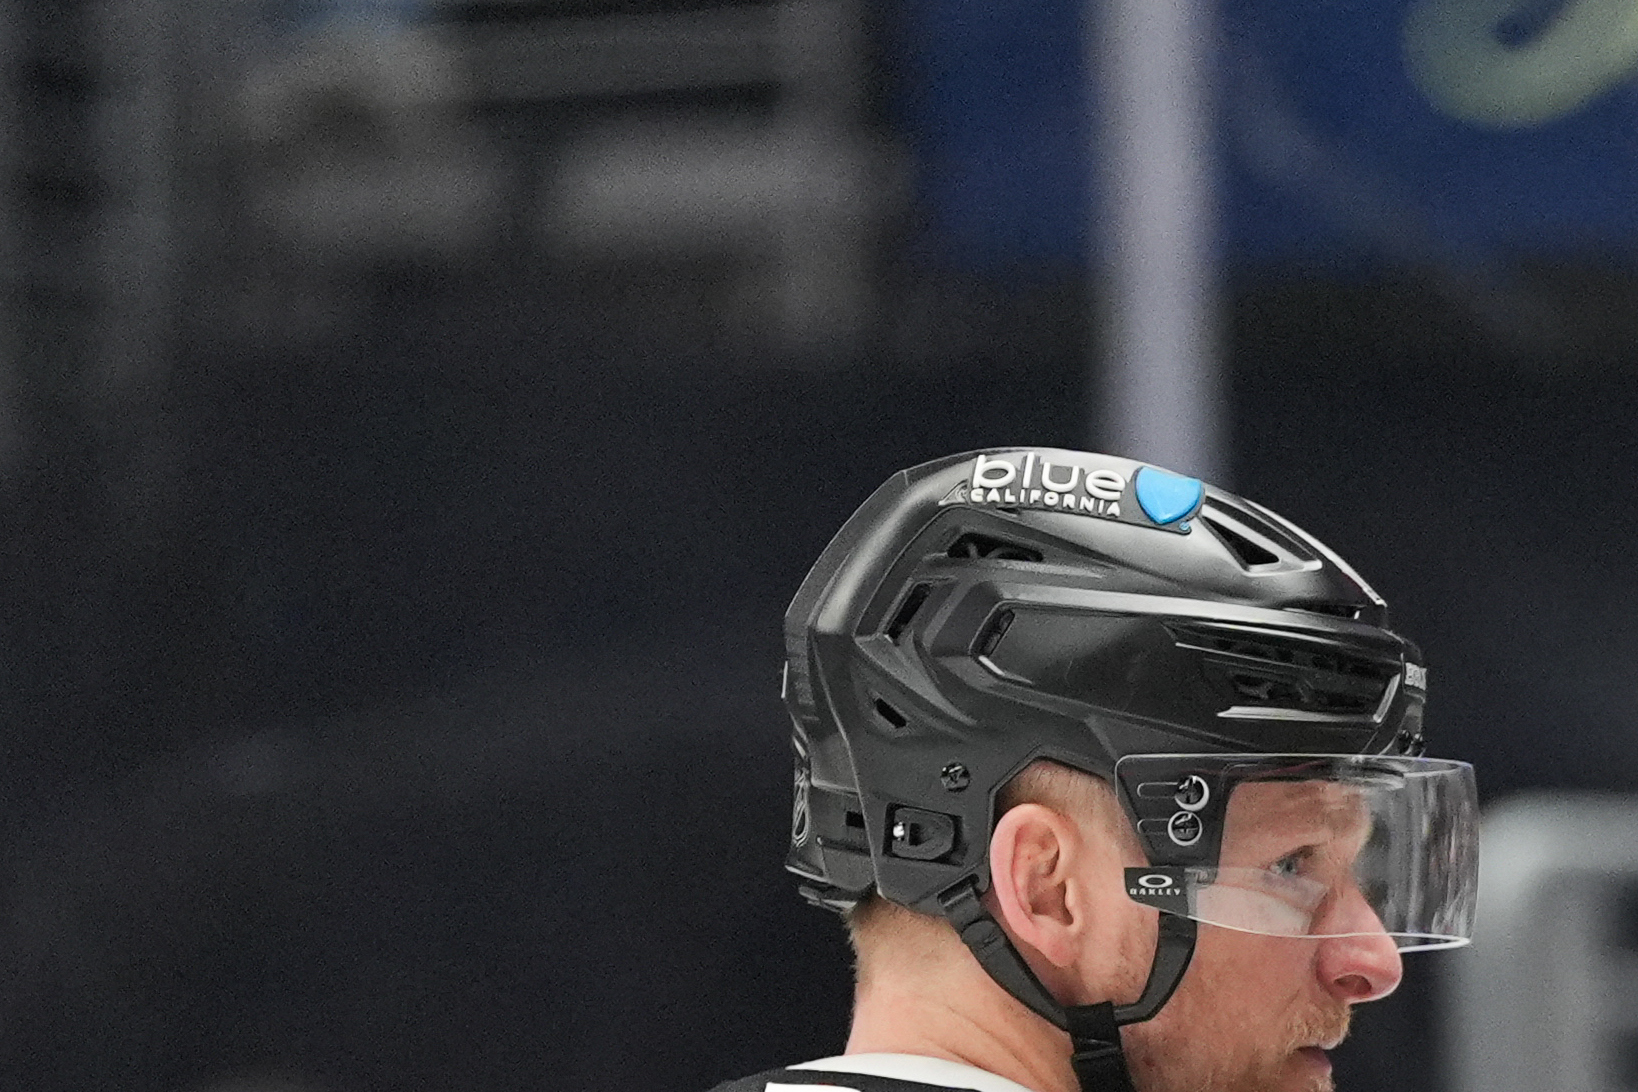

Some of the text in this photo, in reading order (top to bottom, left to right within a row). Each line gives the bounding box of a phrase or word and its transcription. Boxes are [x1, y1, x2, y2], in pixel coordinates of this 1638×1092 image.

[971, 452, 1126, 501] blue
[970, 488, 1121, 517] CALIFORNIA
[1129, 887, 1181, 896] OAKLEY
